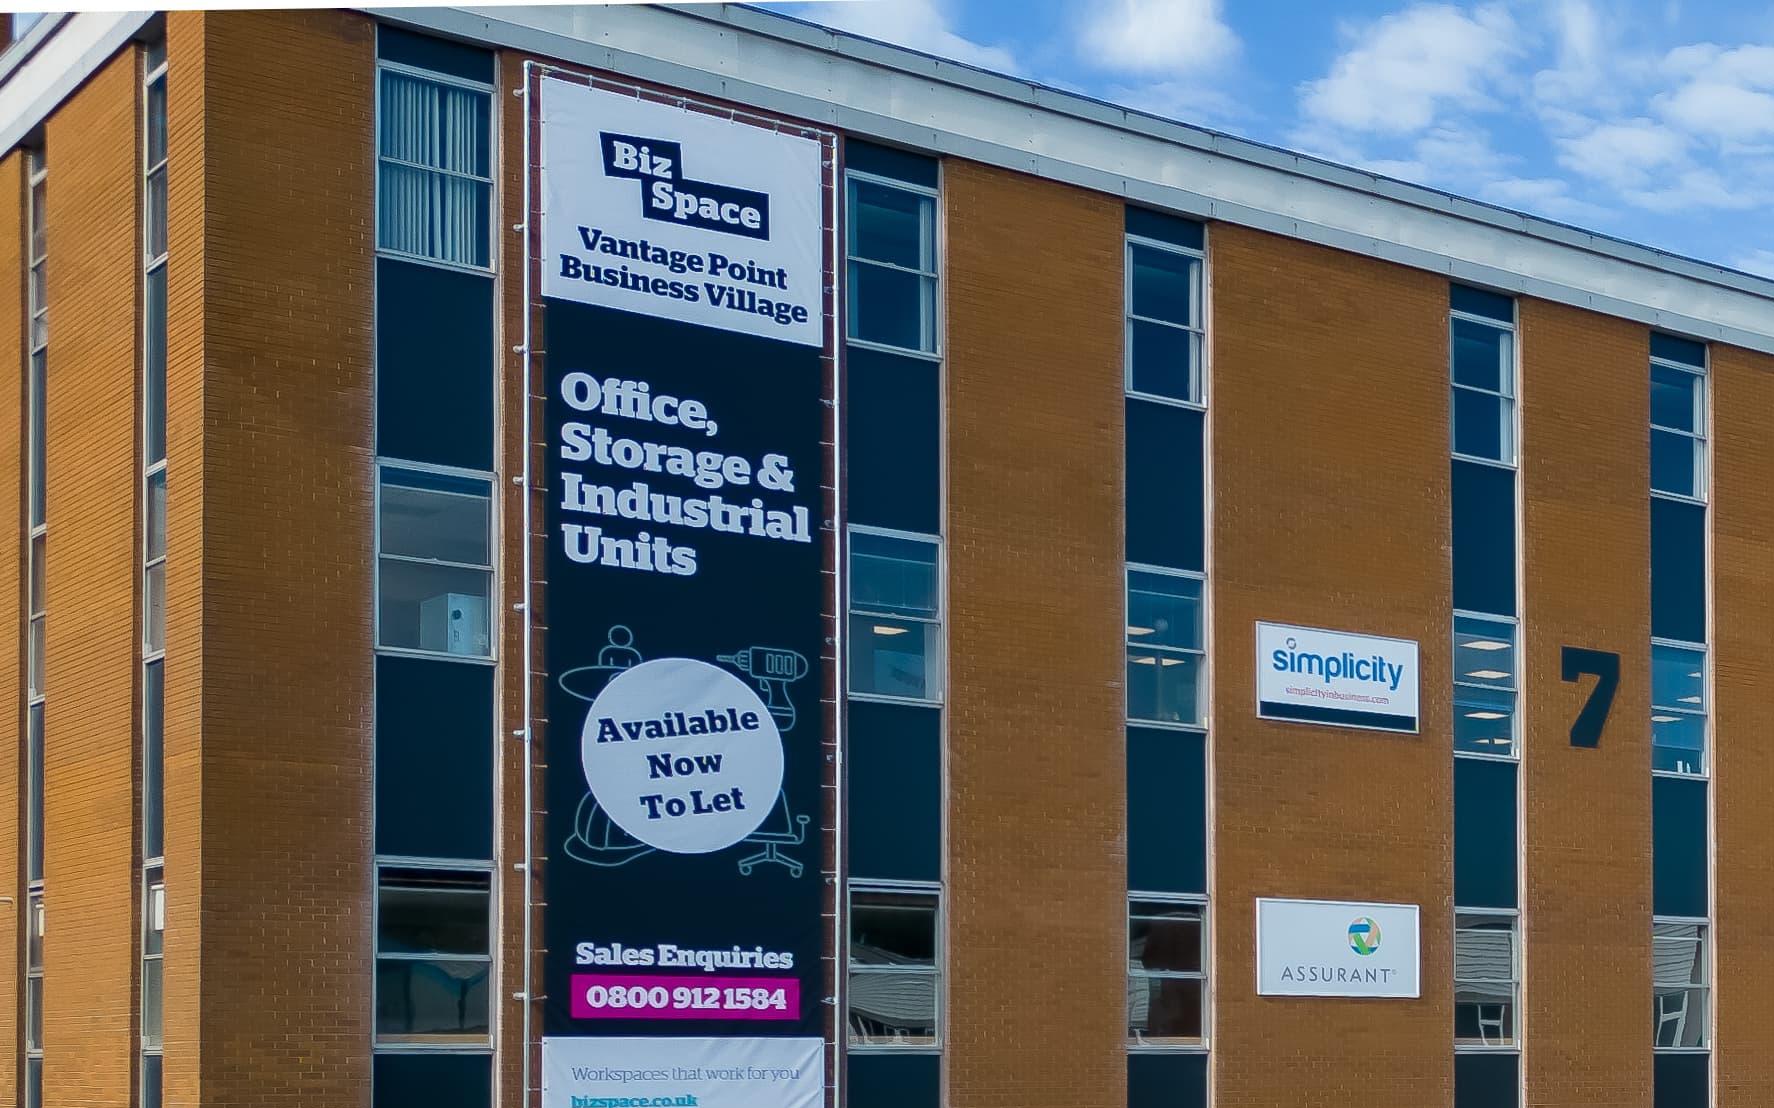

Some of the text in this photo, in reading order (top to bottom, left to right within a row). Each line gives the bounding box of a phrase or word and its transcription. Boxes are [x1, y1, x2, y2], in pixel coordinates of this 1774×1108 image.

[613, 140, 672, 178] Biz
[652, 182, 760, 229] Space
[578, 226, 788, 290] Vantage Point
[560, 254, 808, 325] Business Village
[560, 372, 718, 436] Office,
[560, 422, 794, 492] Storage &
[560, 472, 812, 542] Industrial
[560, 523, 697, 576] Units
[1272, 638, 1403, 691] simplicity
[1562, 646, 1620, 748] 7
[597, 708, 760, 743] Available
[646, 754, 722, 779] Now
[640, 788, 746, 820] To Let
[576, 942, 794, 971] Sales Enquiries
[1281, 966, 1390, 983] ASSURANT
[586, 986, 787, 1010] 0800 912 1584
[572, 1066, 800, 1082] Workspaces that work for you
